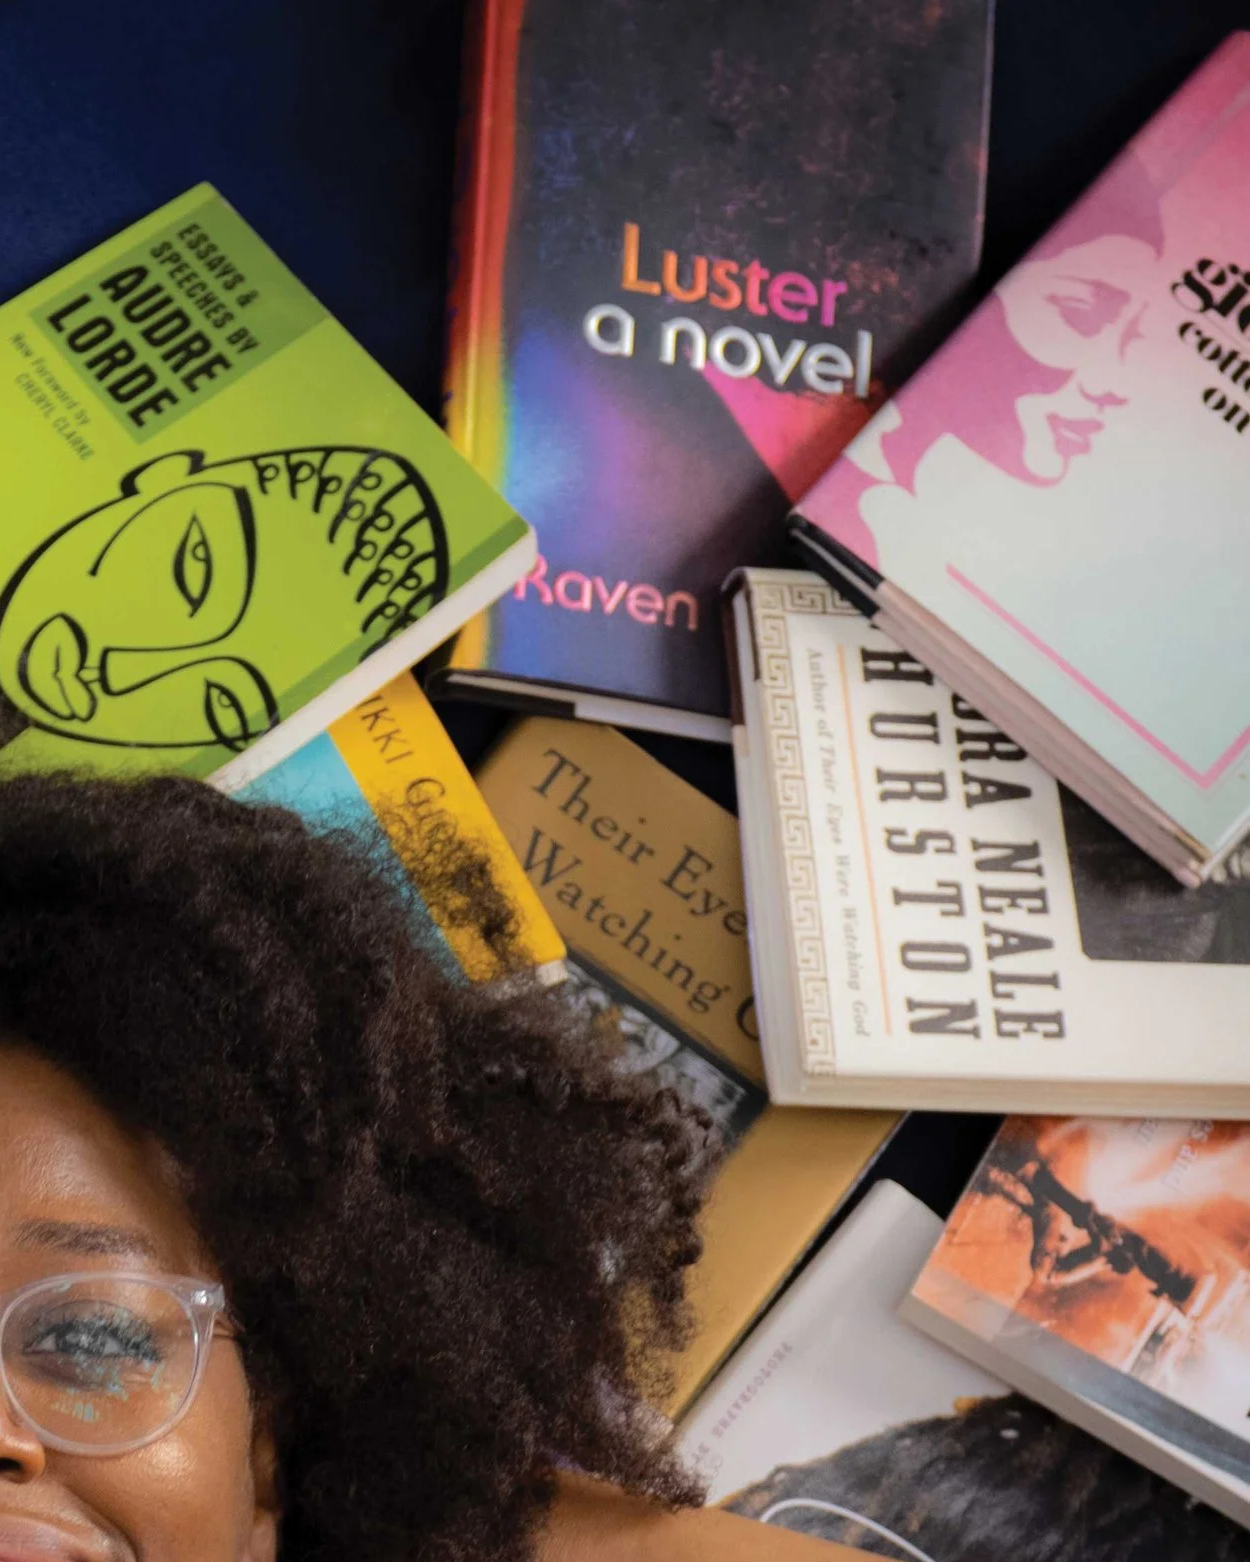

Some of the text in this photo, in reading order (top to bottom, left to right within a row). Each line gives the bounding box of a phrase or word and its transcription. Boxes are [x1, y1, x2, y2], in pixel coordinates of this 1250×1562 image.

[149, 240, 262, 355] SPEECHES BY
[177, 223, 260, 308] ESSAYS &
[621, 222, 848, 329] Luster
[1170, 257, 1250, 340] gi
[11, 332, 33, 361] New
[47, 292, 180, 429] LORDE
[99, 265, 233, 394] AUDRE
[584, 304, 873, 399] a novel
[1178, 321, 1250, 393] cott
[14, 372, 95, 462] CHERYL CLARKE
[513, 553, 699, 632] Raven
[355, 694, 414, 764] IKKI
[531, 749, 656, 866] Their
[660, 845, 748, 937] Eye
[807, 648, 871, 1037] Author of Their Eyes Were Watching God
[860, 646, 982, 1041] HURSTON
[521, 828, 731, 1015] Watching
[969, 838, 1067, 1040] NEALE
